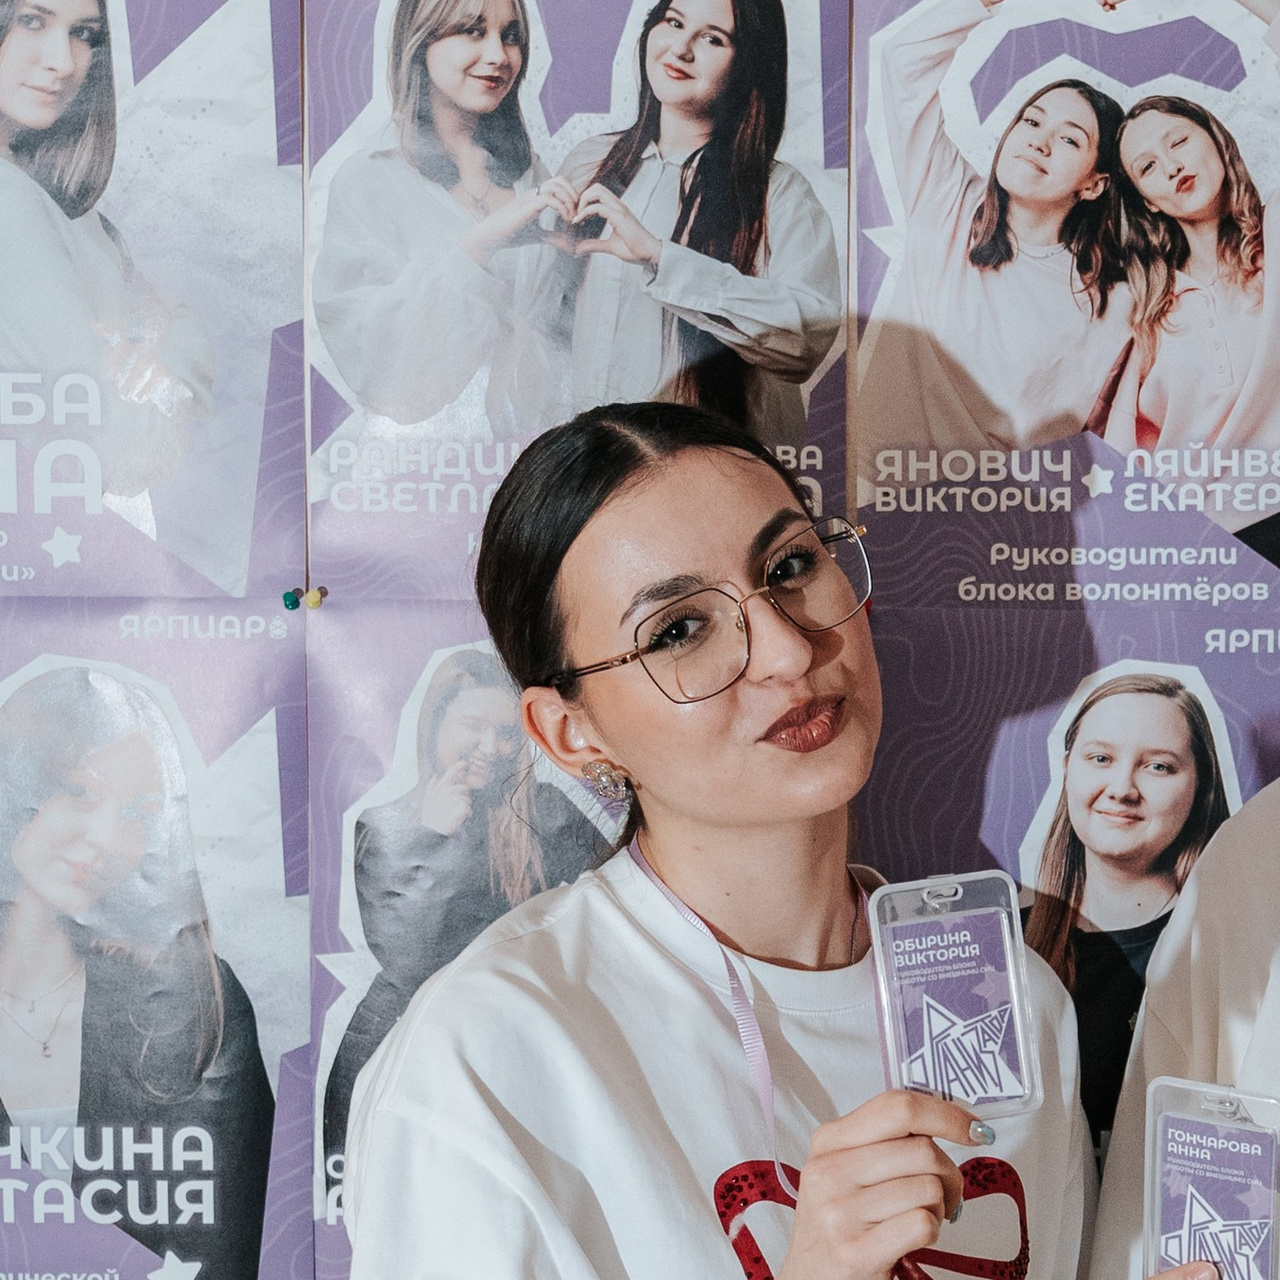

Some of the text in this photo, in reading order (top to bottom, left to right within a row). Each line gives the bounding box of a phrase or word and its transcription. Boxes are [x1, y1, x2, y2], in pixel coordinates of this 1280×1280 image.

[329, 440, 520, 481] РАНДИ
[875, 449, 1072, 482] ЯНОВИЧ
[875, 486, 1072, 512] ВИКТОРИЯ
[990, 543, 1237, 571] Руководители
[958, 576, 1269, 606] блока волонтёров
[118, 615, 266, 640] ЯРПИАР
[892, 930, 971, 953] ОБИРИНА
[894, 943, 980, 968] ВИКТОРИЯ
[1168, 1128, 1262, 1156] ГОНЧАРОВА
[1168, 1142, 1211, 1160] АННА
